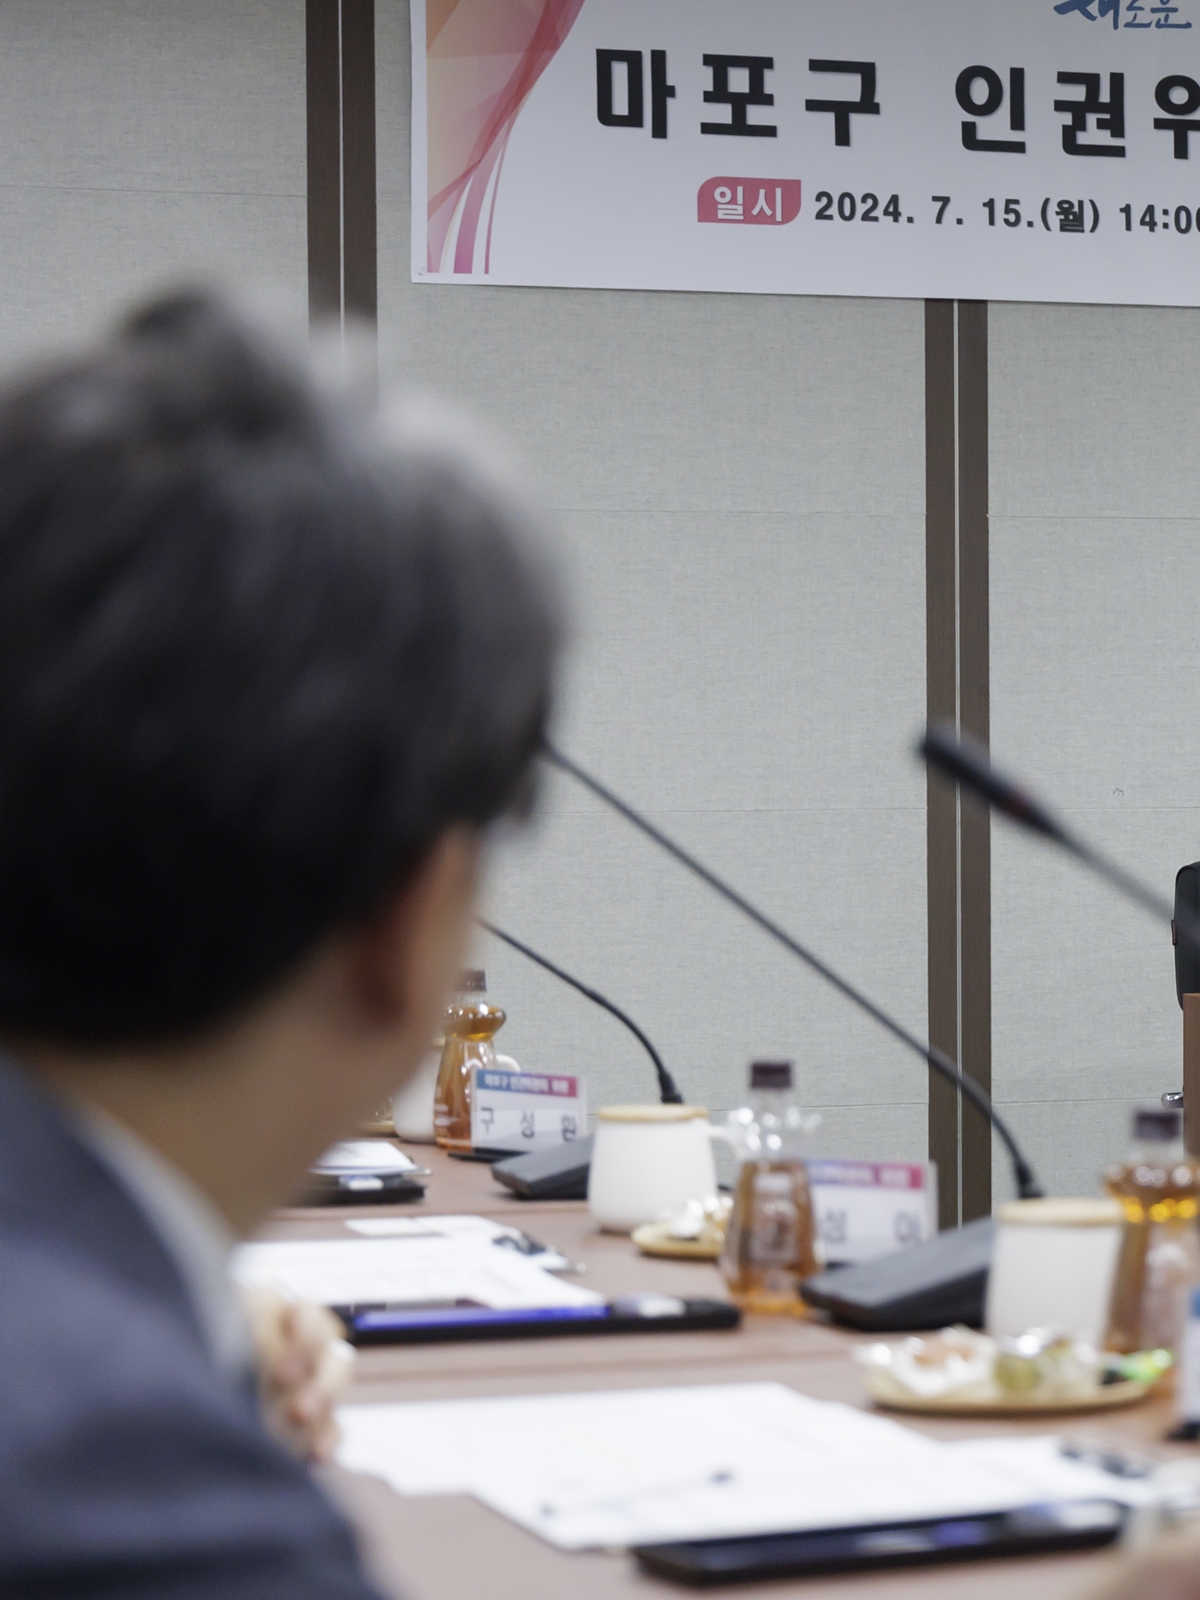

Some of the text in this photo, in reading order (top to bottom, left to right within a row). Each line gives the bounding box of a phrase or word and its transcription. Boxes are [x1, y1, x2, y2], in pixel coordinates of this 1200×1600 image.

[1053, 0, 1192, 30] 새로운
[596, 48, 881, 147] 마포구
[714, 186, 783, 222] 일시
[815, 191, 914, 224] 2024.
[932, 196, 964, 226] 7.
[983, 198, 1100, 234] 15.(월)
